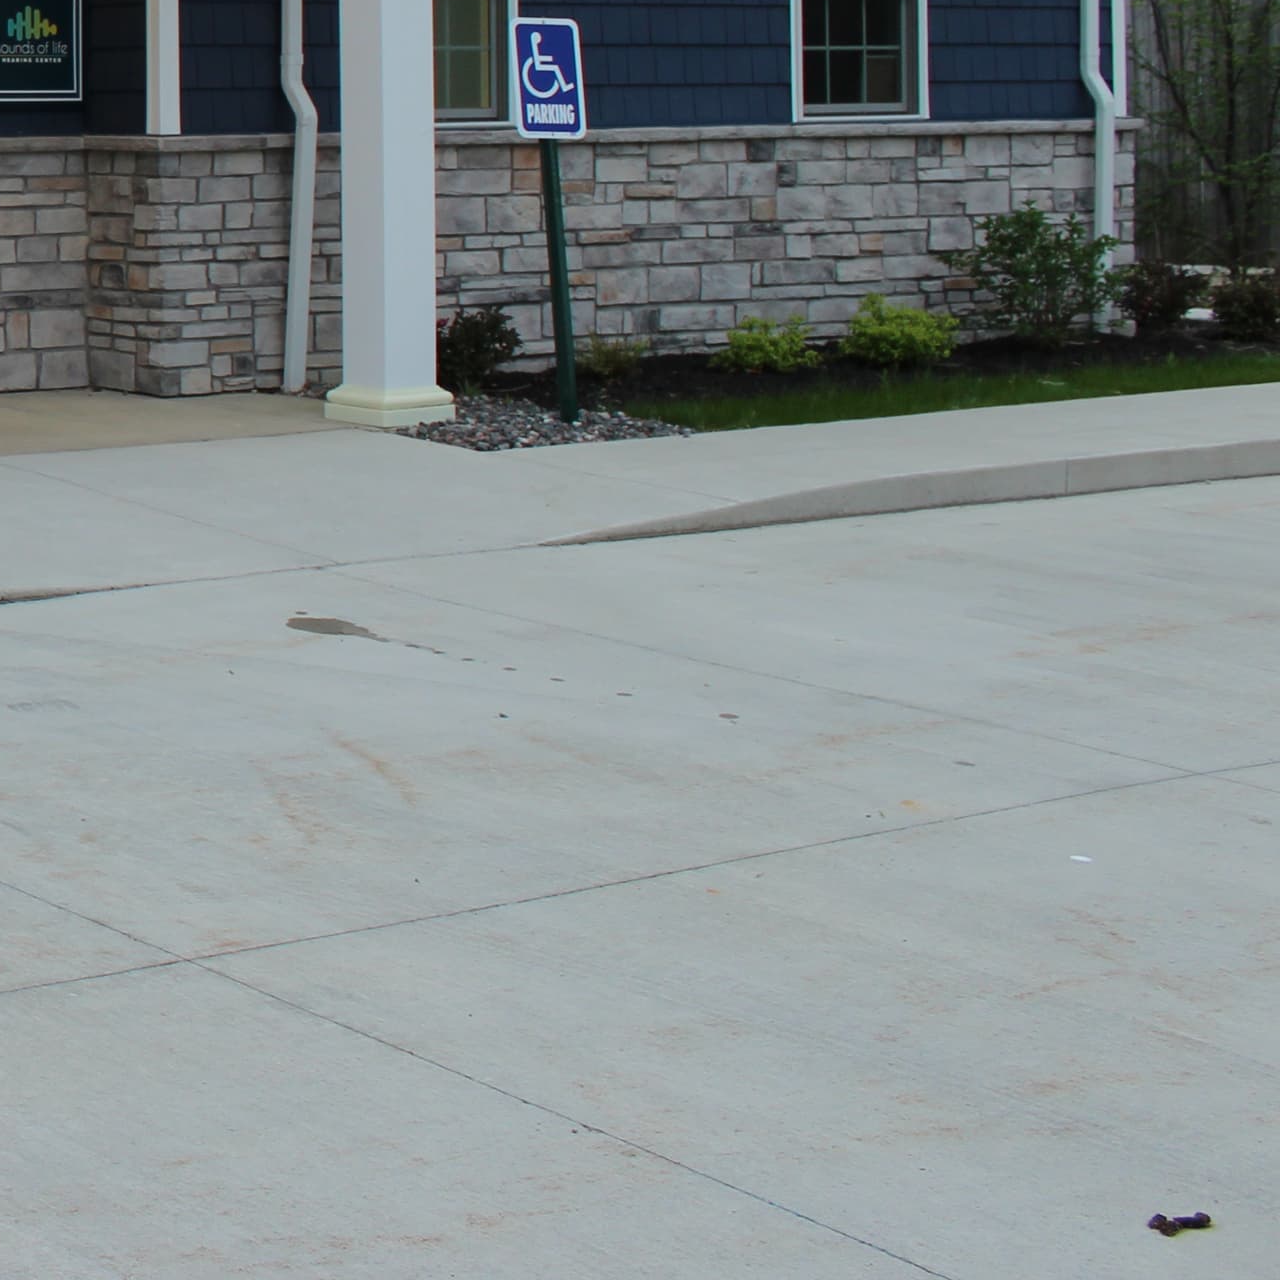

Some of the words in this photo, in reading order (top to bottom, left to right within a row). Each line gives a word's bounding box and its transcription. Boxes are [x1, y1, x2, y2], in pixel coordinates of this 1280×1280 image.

[37, 41, 49, 54] of
[52, 41, 68, 54] life
[526, 103, 575, 125] PARKING
